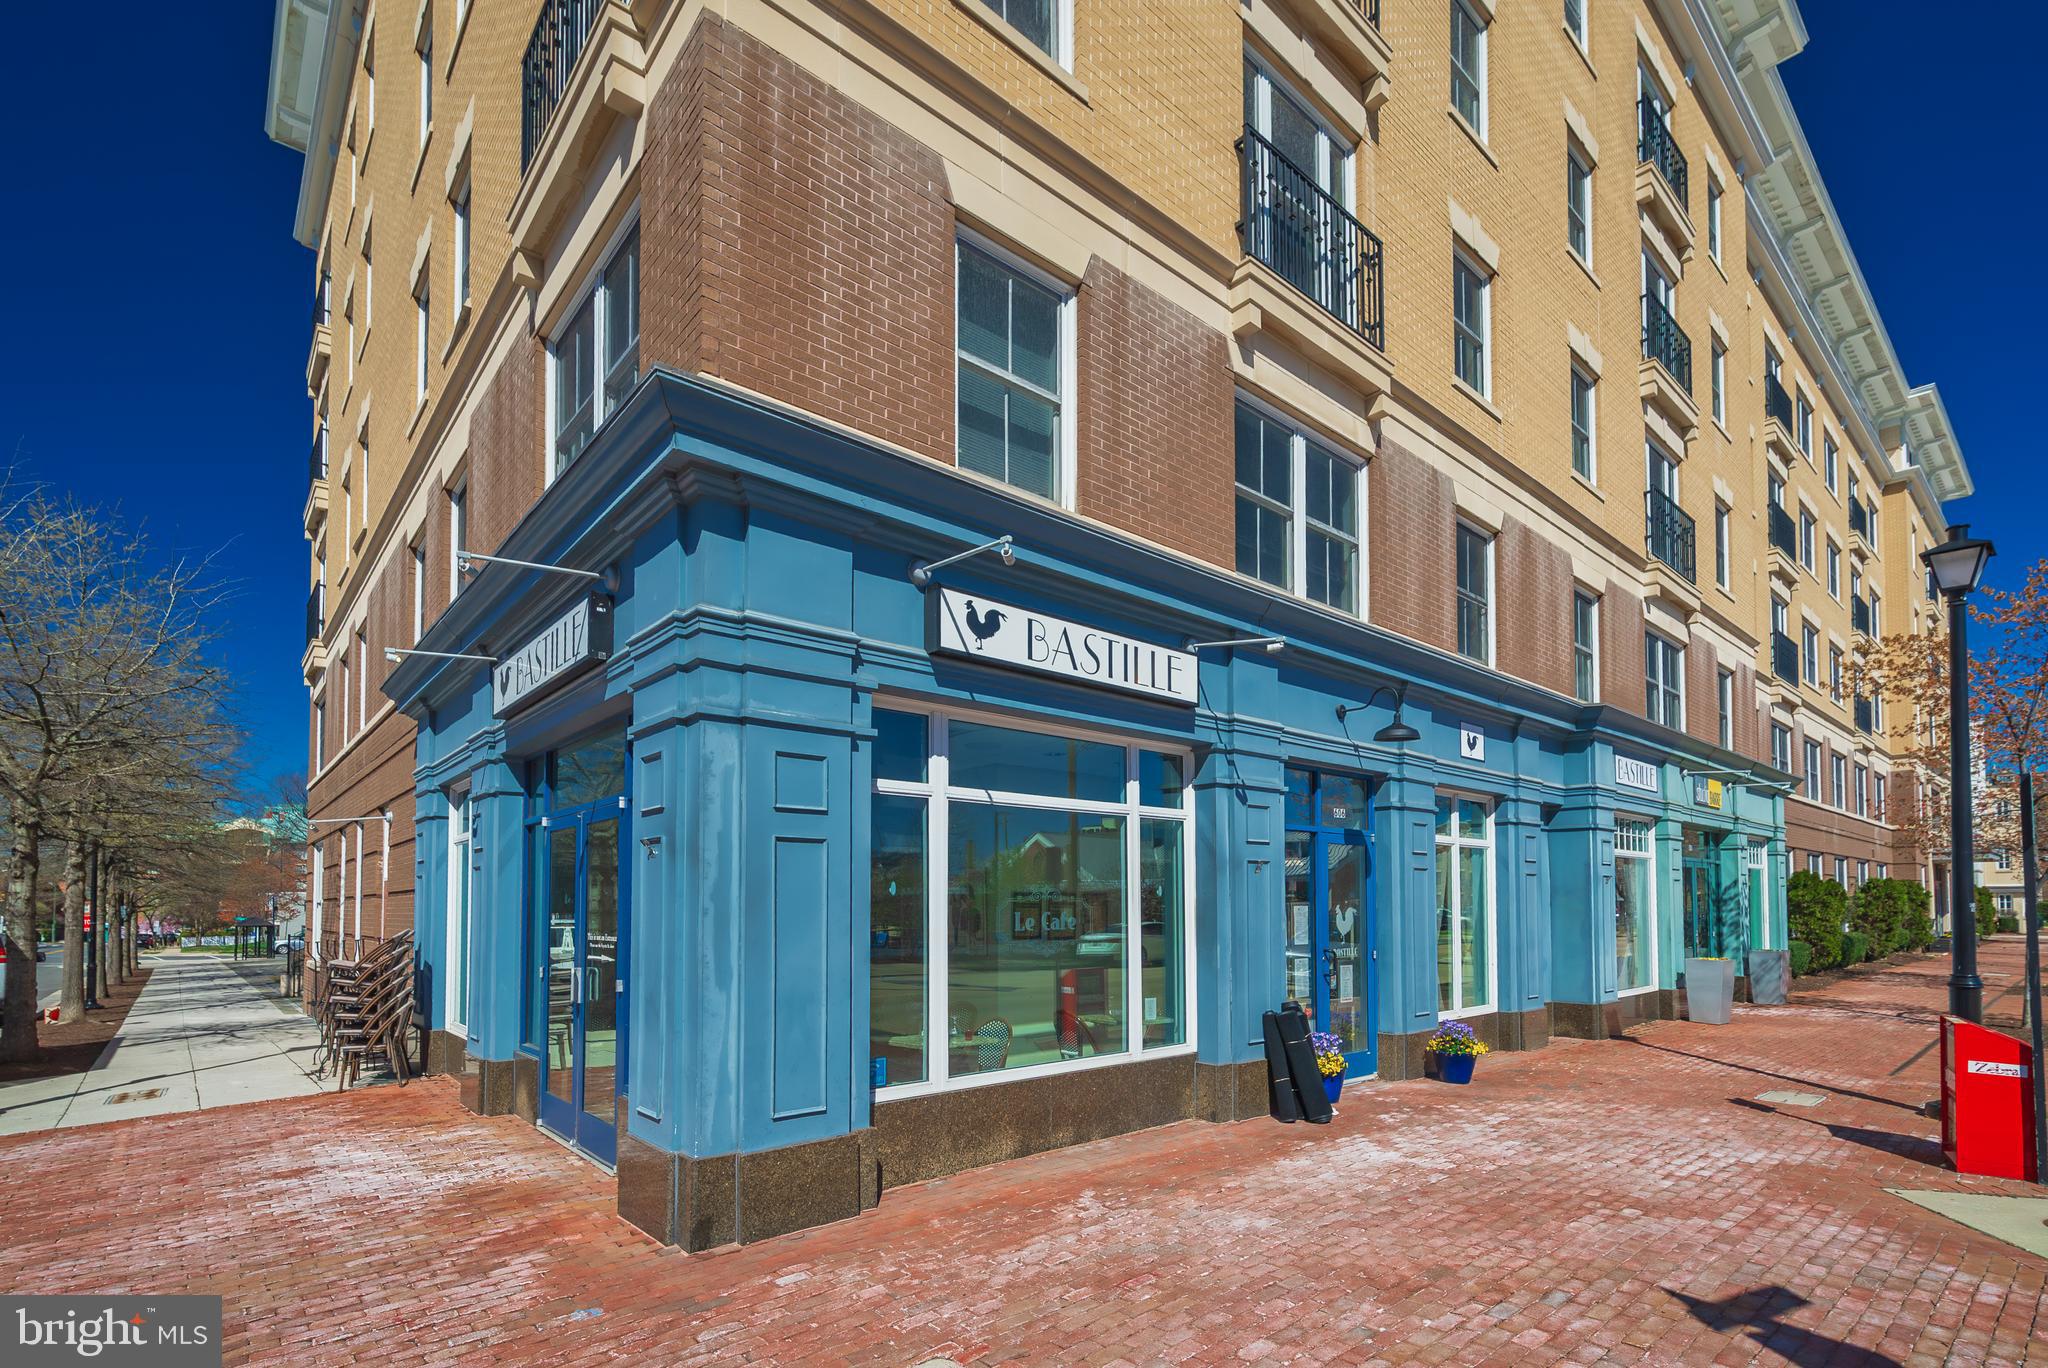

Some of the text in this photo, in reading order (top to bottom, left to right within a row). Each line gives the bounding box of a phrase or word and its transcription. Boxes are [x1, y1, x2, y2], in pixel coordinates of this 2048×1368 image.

[516, 610, 582, 697] BASTILLE
[1027, 618, 1183, 695] BASTILLE
[1617, 759, 1656, 788] BASTILLE
[1014, 911, 1036, 931] Le
